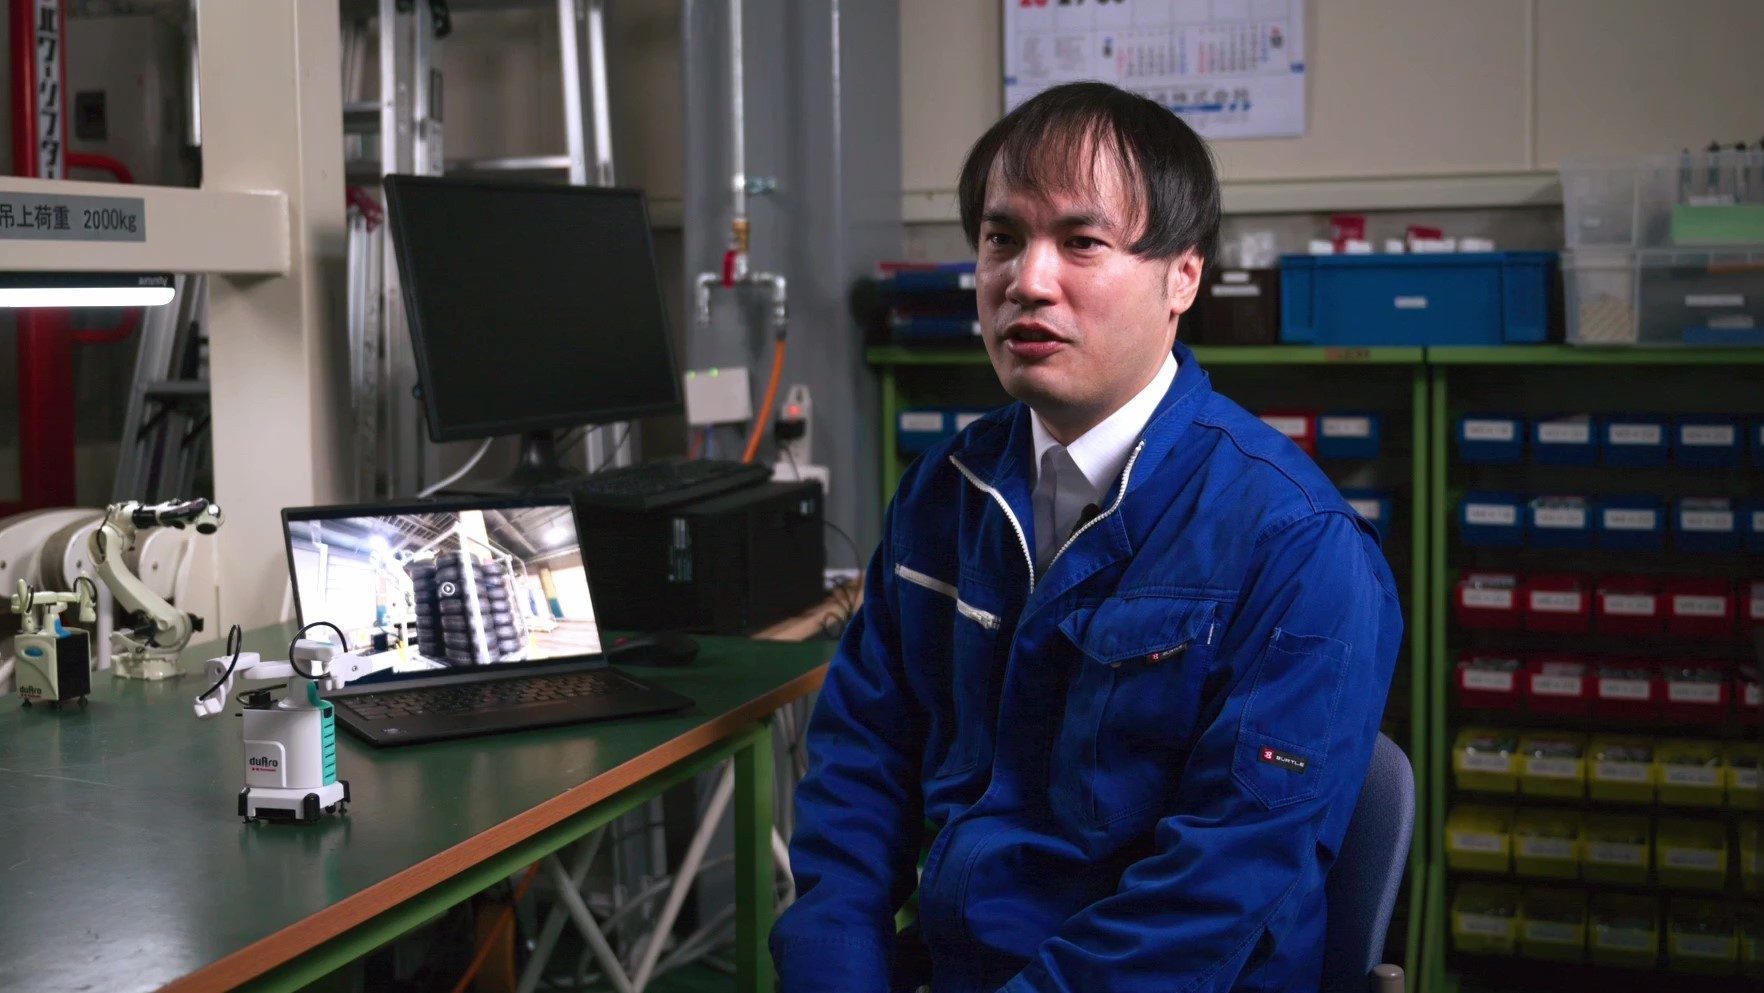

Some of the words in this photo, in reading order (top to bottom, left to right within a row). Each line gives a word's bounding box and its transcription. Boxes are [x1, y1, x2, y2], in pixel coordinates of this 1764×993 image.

[0, 204, 71, 231] 吊上荷重
[83, 208, 137, 233] 2000kg
